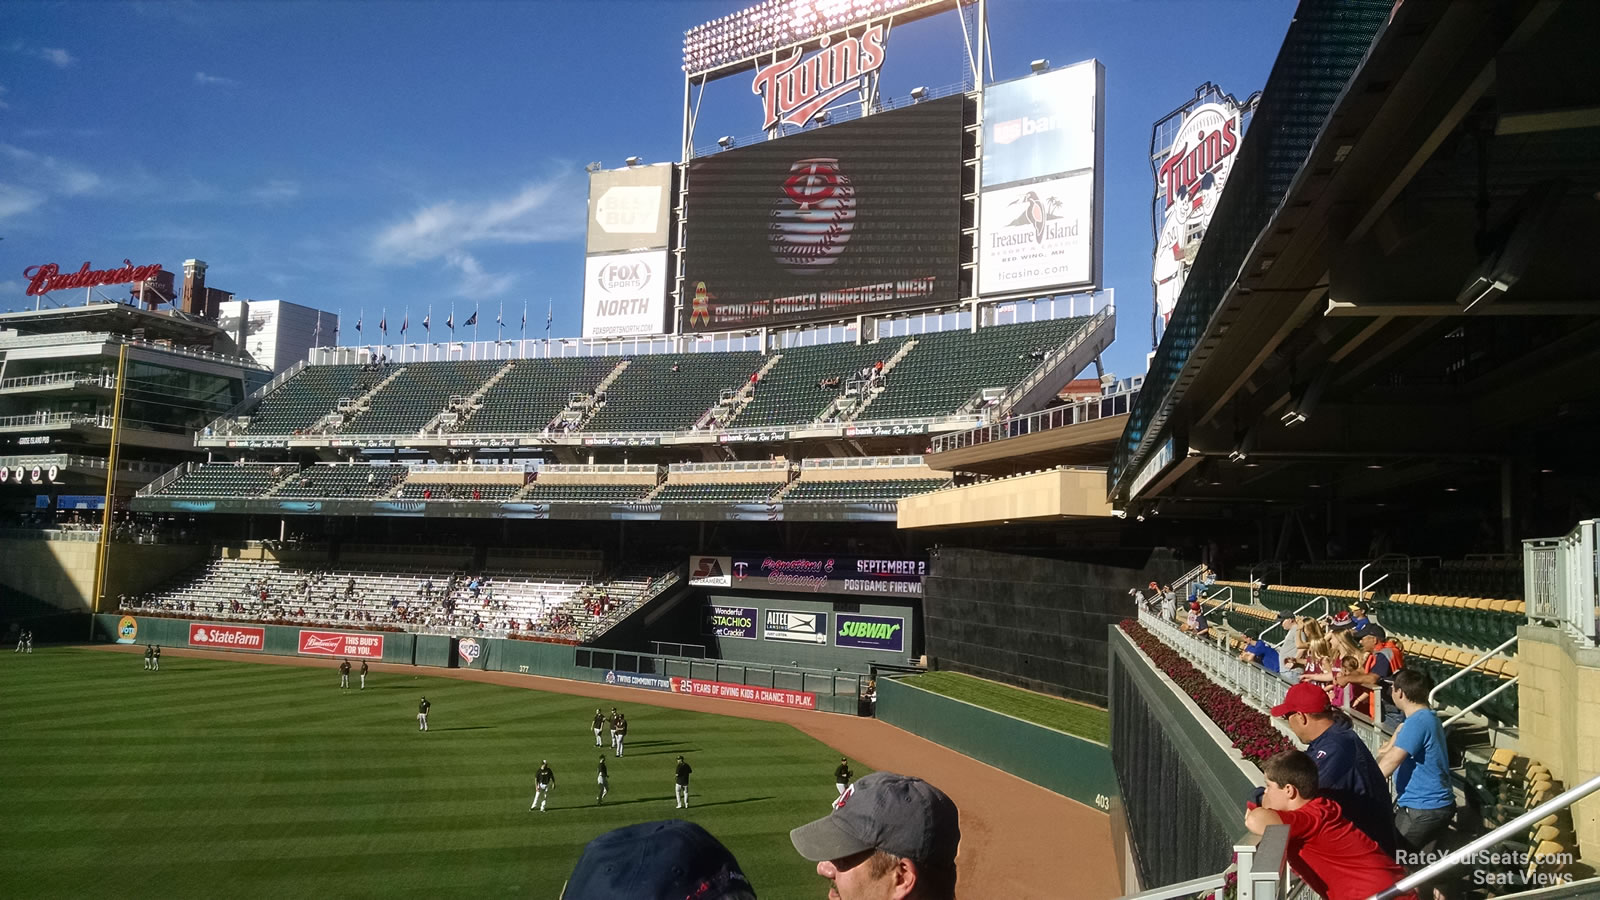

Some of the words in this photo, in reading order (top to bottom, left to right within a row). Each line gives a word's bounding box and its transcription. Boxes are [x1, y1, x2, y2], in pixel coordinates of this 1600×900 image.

[752, 23, 884, 131] Twins
[1159, 117, 1237, 210] Twins
[990, 231, 1034, 248] Treasure
[1045, 218, 1079, 240] Island
[23, 258, 162, 297] Budweiser
[609, 264, 641, 281] FOX
[998, 264, 1069, 281] ticasino.com
[608, 280, 641, 289] SPORTS
[773, 292, 817, 314] CANCER
[820, 282, 893, 306] AWARENESS
[896, 276, 937, 298] NIGHT
[596, 298, 650, 317] NORTH
[592, 323, 654, 335] FOXSPORTSNORTH.COM
[874, 426, 891, 435] Home
[892, 425, 905, 435] Run
[761, 557, 821, 573] Promotions
[825, 559, 835, 573] &
[857, 559, 915, 575] SEPTEMBER
[768, 570, 828, 592] Giveaways
[844, 580, 888, 592] POSTGAME
[706, 615, 752, 628] STACHIOS
[767, 612, 788, 625] ALTEC
[839, 621, 900, 640] SUBWAY
[345, 636, 359, 645] THIS
[360, 637, 379, 646] BUD'S
[344, 646, 357, 654] FOR
[357, 647, 372, 655] YOU.
[468, 644, 479, 656] 29
[519, 665, 529, 673] 377
[617, 675, 631, 683] TWINS
[631, 676, 657, 687] COMMUNITY
[657, 679, 669, 688] FUND
[680, 679, 692, 693] 25
[693, 683, 711, 693] YEARS
[712, 685, 719, 695] OF
[720, 686, 740, 697] GIVING
[740, 688, 754, 699] KIDS
[754, 690, 760, 700] A
[761, 690, 785, 703] CHANCE
[786, 693, 794, 704] TO
[795, 694, 813, 706] PLAY.
[1095, 793, 1110, 810] 403
